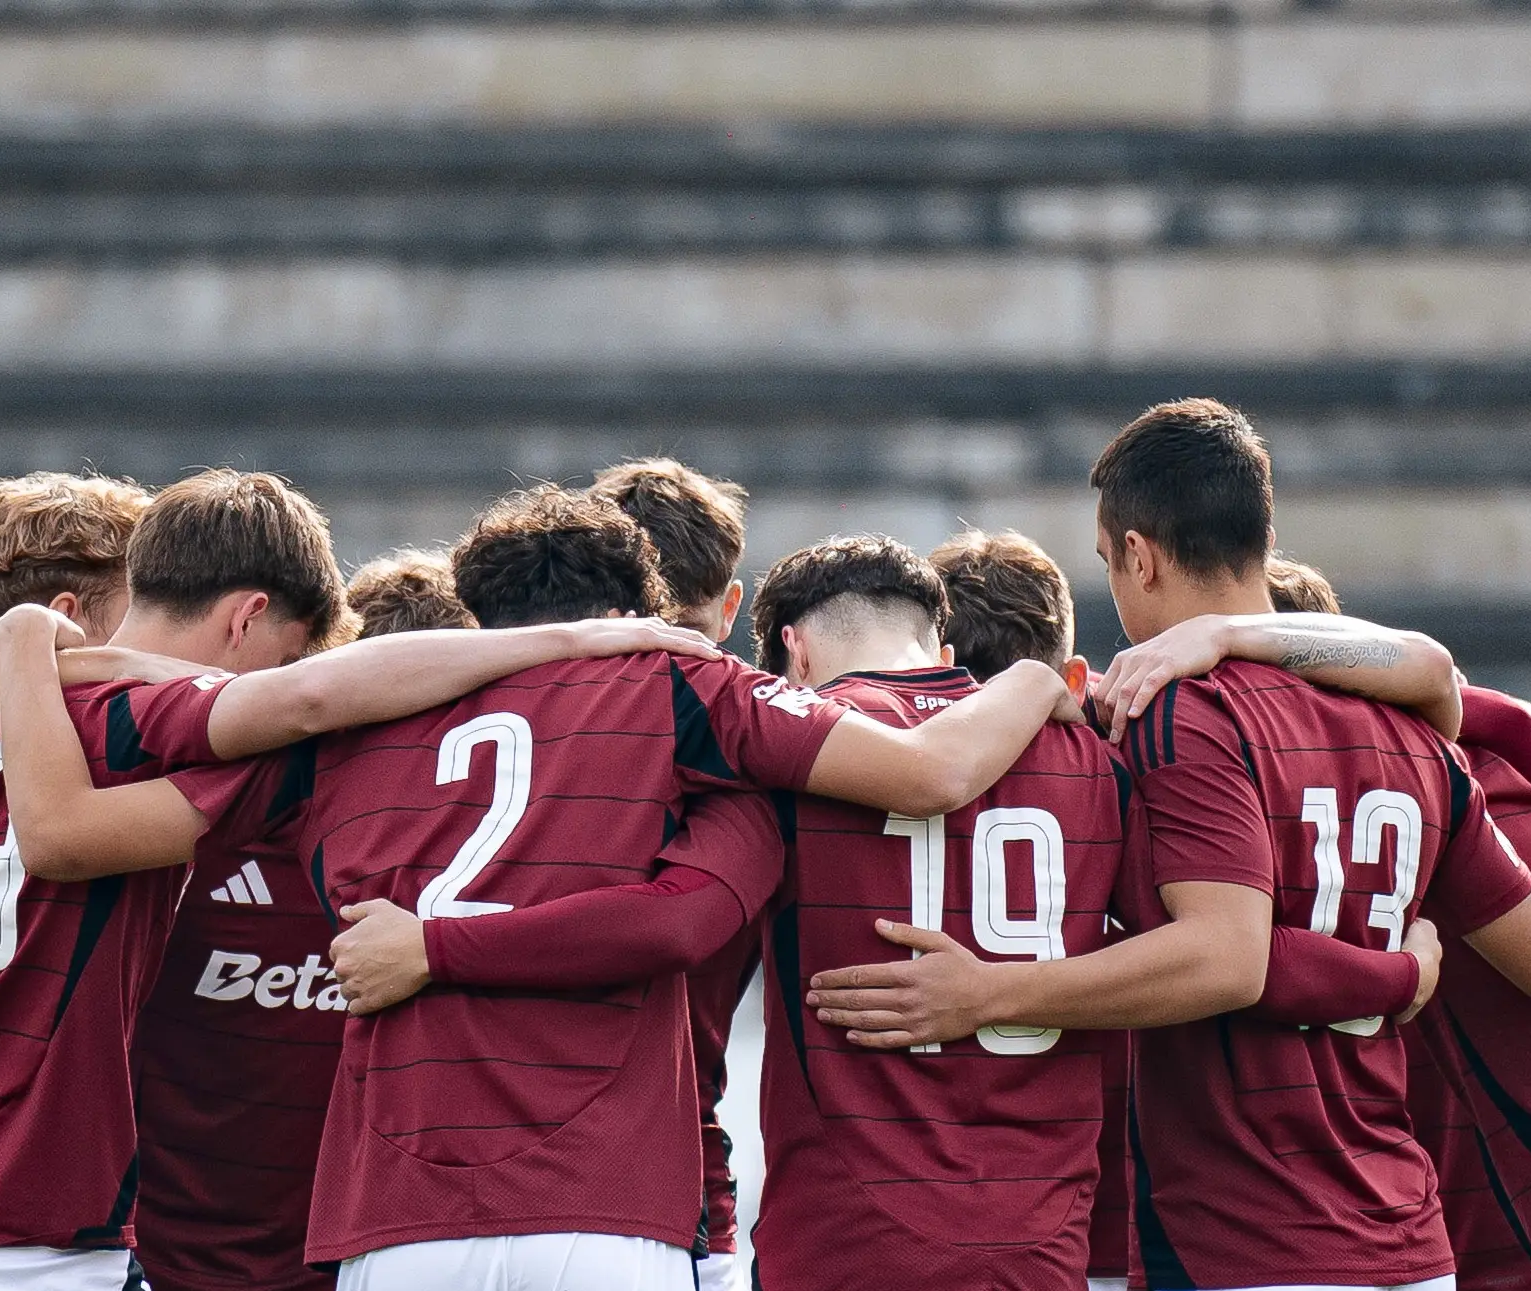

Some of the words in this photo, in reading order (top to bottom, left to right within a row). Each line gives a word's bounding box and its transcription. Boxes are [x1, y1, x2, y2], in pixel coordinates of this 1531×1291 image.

[417, 711, 533, 921] 2
[883, 807, 1067, 1055] 19
[1299, 786, 1423, 1037] 13
